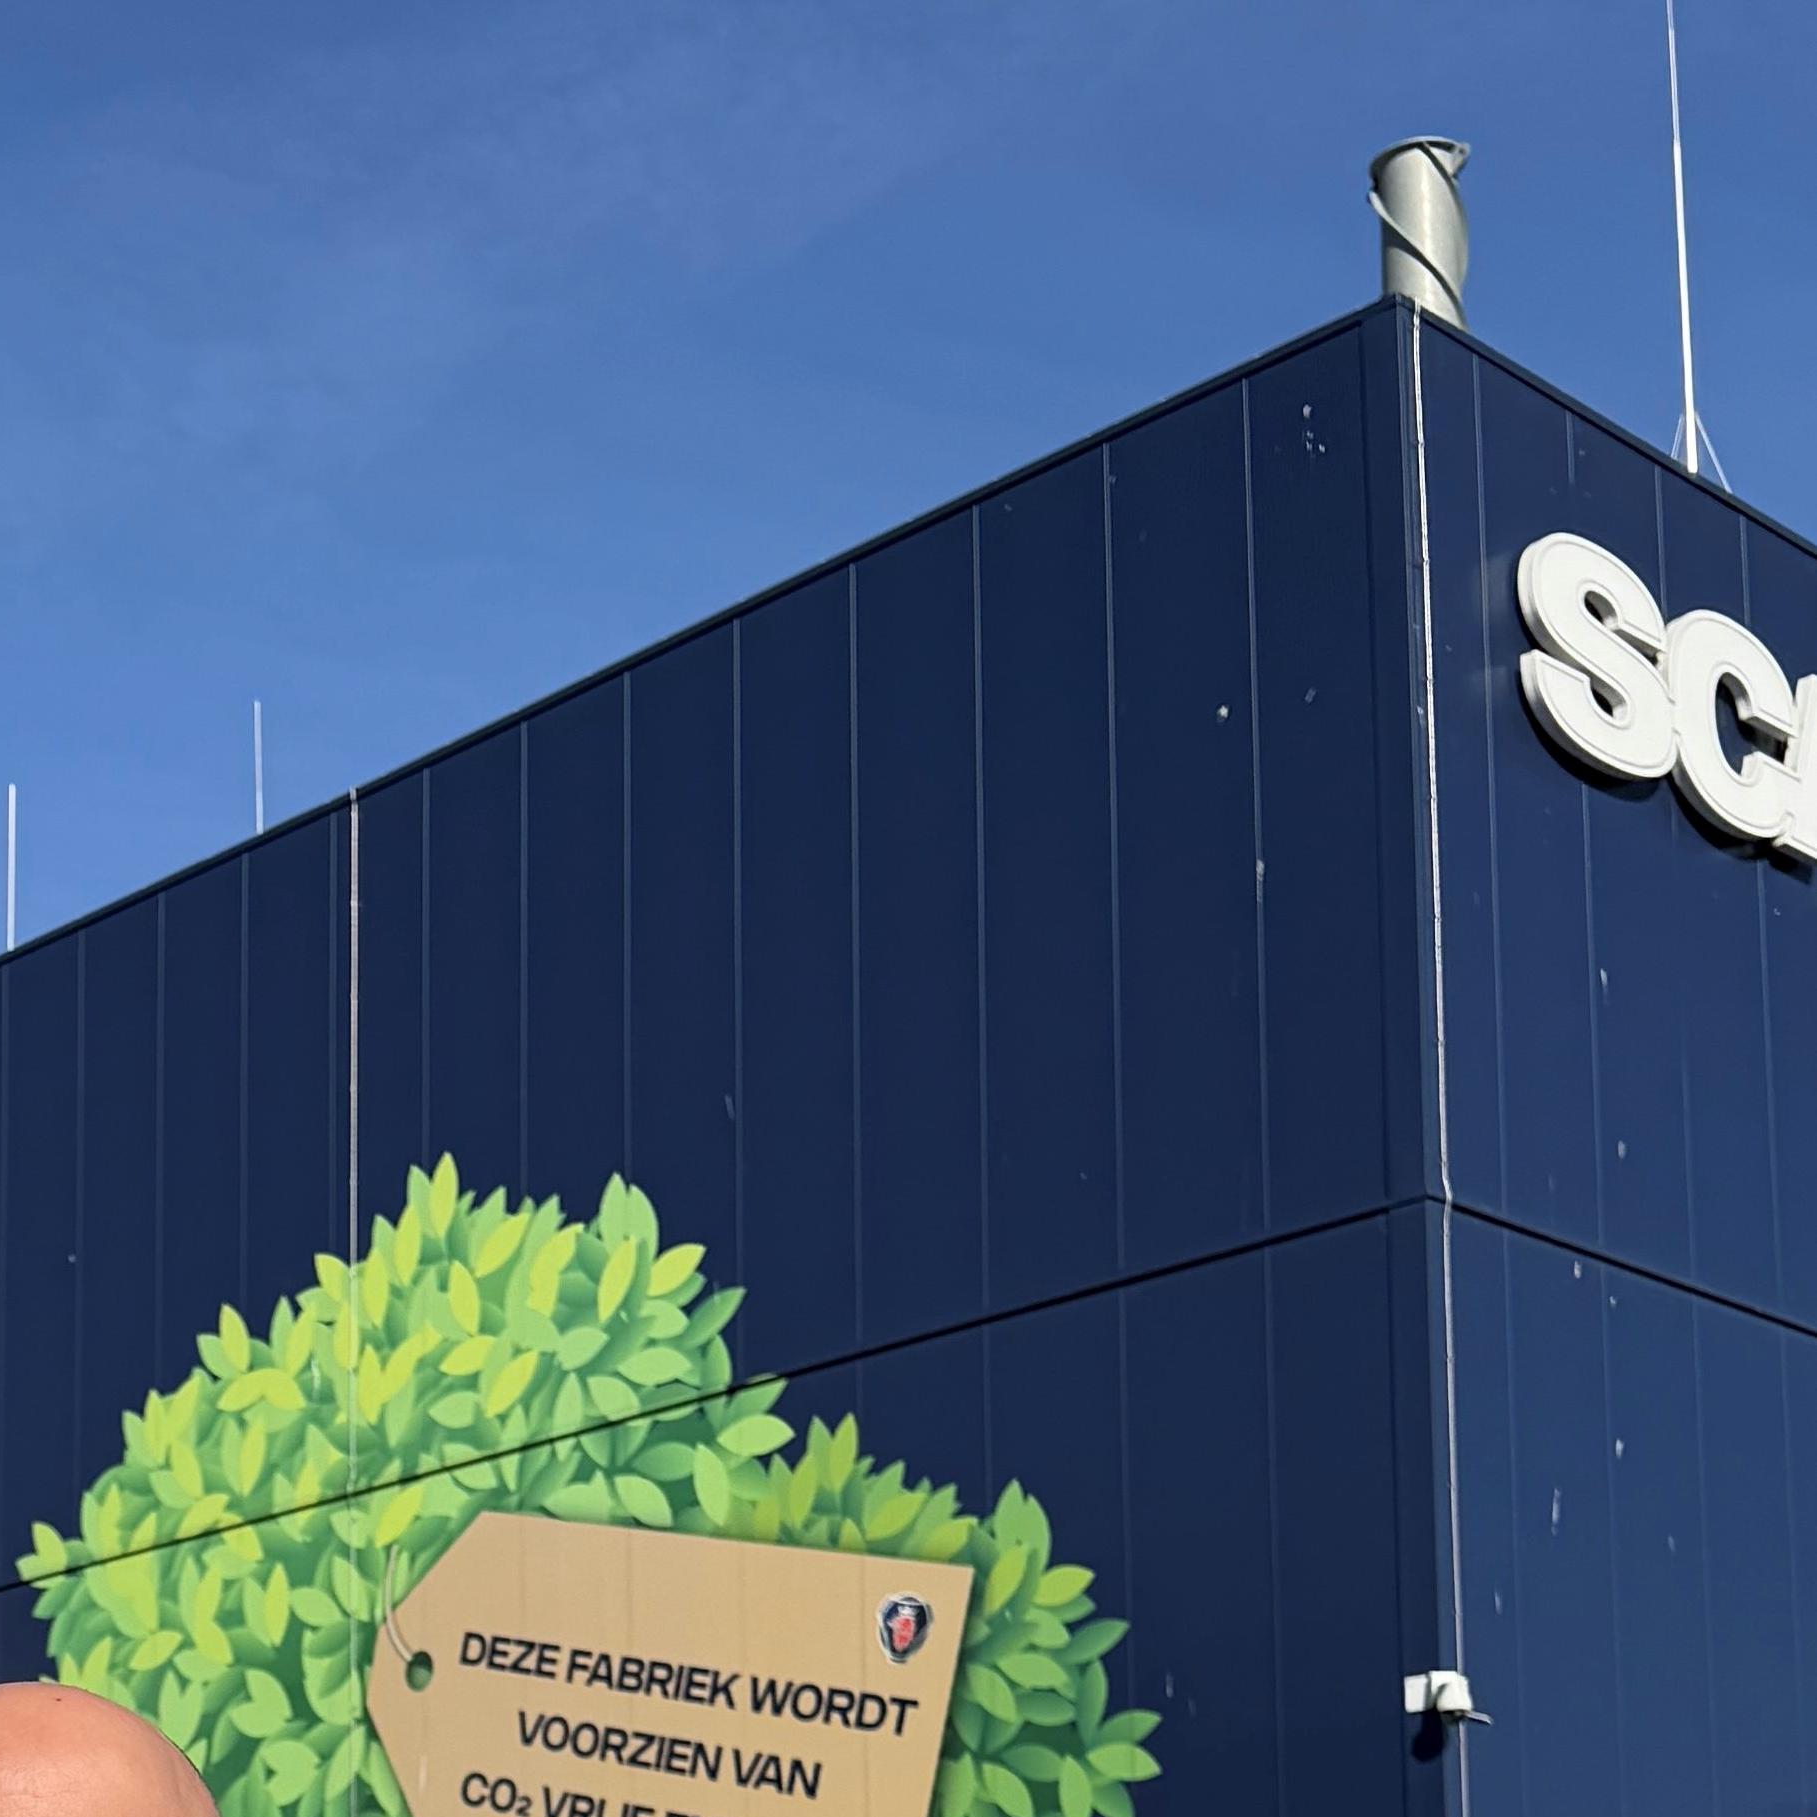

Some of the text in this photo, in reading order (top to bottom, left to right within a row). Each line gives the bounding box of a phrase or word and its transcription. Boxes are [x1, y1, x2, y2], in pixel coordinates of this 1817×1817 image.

[459, 1631, 918, 1736] DEZE FABRIEK WORDT
[517, 1710, 822, 1800] VOORZIEN VAN
